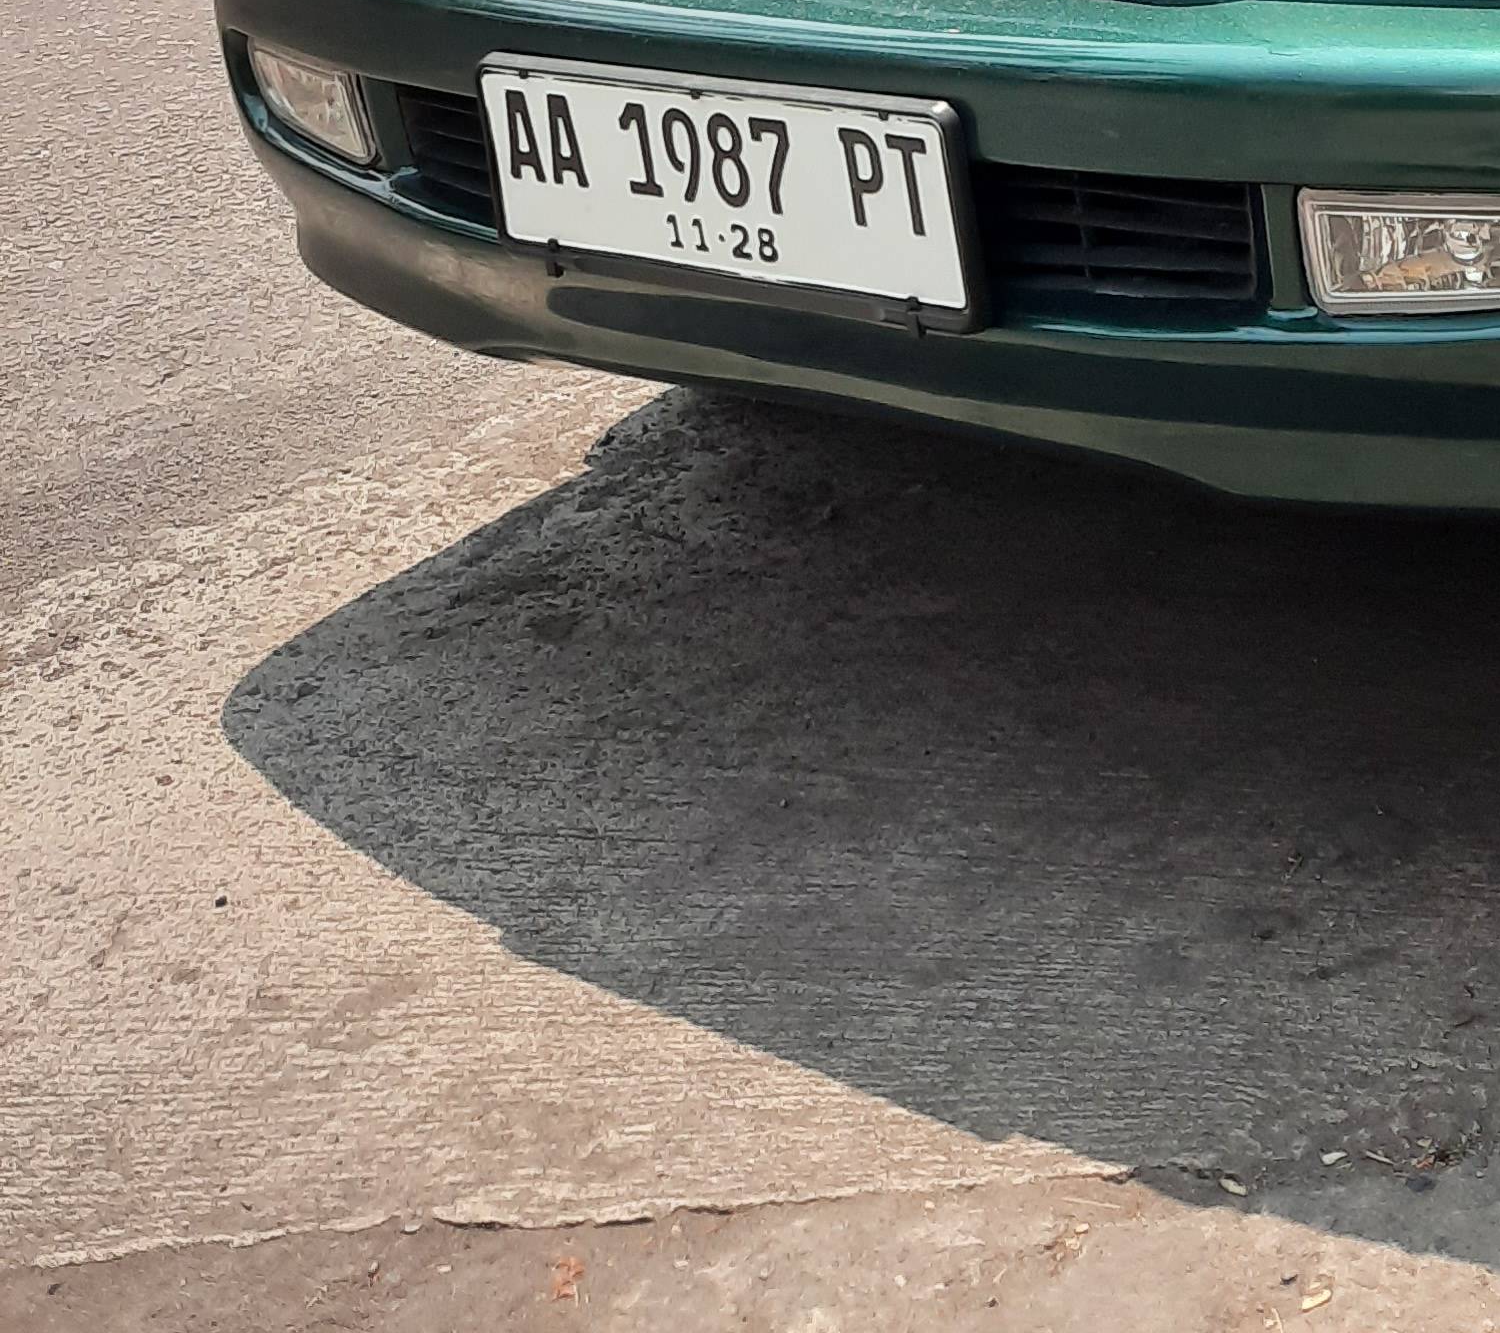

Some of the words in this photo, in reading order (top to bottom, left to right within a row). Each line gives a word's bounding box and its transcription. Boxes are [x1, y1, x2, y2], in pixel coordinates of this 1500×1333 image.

[505, 89, 590, 189] AA
[618, 102, 791, 216] 1987
[837, 127, 927, 237] PT
